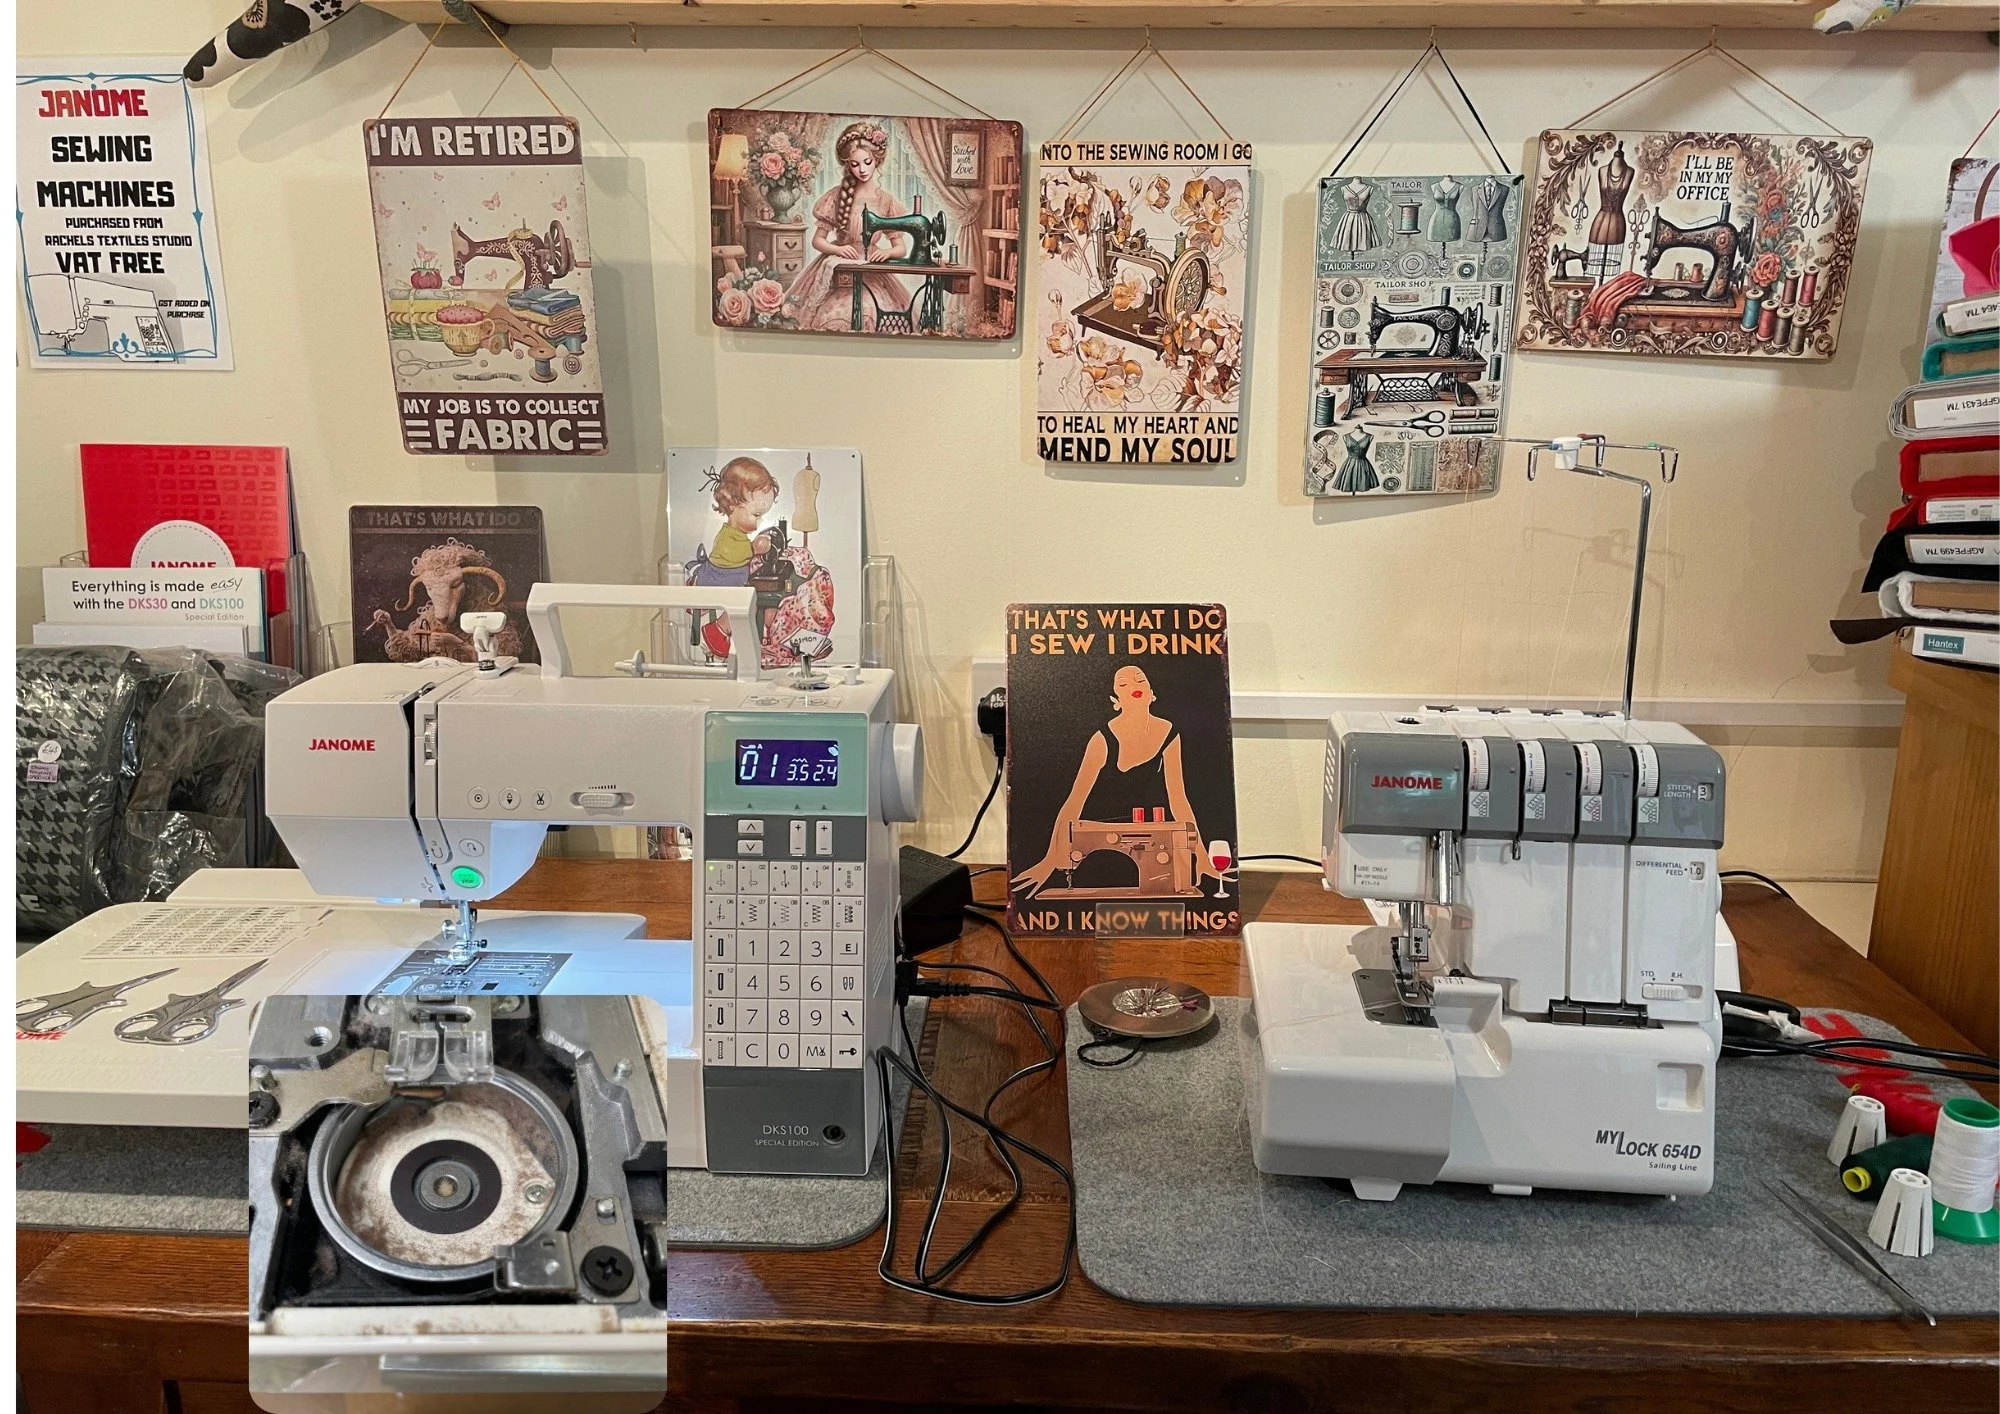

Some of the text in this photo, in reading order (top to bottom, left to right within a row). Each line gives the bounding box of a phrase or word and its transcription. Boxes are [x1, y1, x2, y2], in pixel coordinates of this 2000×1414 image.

[39, 89, 149, 117] JANOME
[370, 124, 575, 157] I'M RETIRED
[51, 135, 152, 162] SEWING
[1040, 144, 1252, 160] NTO THE SEWING ROOM I GO
[954, 163, 973, 175] Love
[1685, 155, 1734, 170] I'LL BE
[1679, 171, 1733, 184] IN MY MY
[36, 180, 175, 208] MACHINES
[1677, 186, 1729, 200] OFFICE
[65, 217, 163, 229] PURCHASED FROM
[45, 235, 192, 247] RACHELS TEXTILES STUDIO
[55, 252, 165, 274] VAT FREE
[1324, 262, 1375, 271] TAILOR SHOP
[158, 299, 173, 307] GST
[404, 399, 599, 415] MY JOB IS TO COLLECT
[1947, 403, 1959, 411] 7M
[1037, 416, 1238, 434] TO HEAL MY HEART AND
[435, 418, 574, 451] FABRIC
[1039, 437, 1237, 462] MEND MY SOUL
[367, 512, 427, 526] THAT'S
[430, 512, 483, 526] WHAT
[495, 512, 521, 526] DO
[72, 577, 243, 595] Everything is made easy
[73, 598, 244, 610] with the DKS30 and DKS100
[185, 613, 244, 622] Special Edition
[1012, 609, 1222, 630] THAT'S WHAT I DO
[1011, 633, 1223, 655] I SEW I DRINK
[1928, 638, 1958, 649] Hantex
[308, 739, 376, 752] JANOME
[740, 750, 837, 781] 01 3.5 2.4
[1371, 775, 1443, 790] JANOME
[1636, 860, 1682, 868] DIFFERENTIAL
[1690, 867, 1701, 875] 1.0
[1017, 911, 1239, 930] AND I KNOW THINGS
[748, 940, 755, 956] 1
[779, 940, 790, 956] 2
[811, 941, 822, 957] 3
[747, 975, 758, 990] 4
[779, 975, 790, 991] 5
[810, 975, 822, 991] 6
[746, 1009, 758, 1025] 7
[778, 1009, 790, 1025] 8
[810, 1010, 822, 1026] 9
[746, 1043, 759, 1058] C
[763, 1125, 809, 1135] DKS100
[755, 1139, 786, 1147] SPECIAL
[1662, 1144, 1701, 1159] 654D
[1649, 1162, 1697, 1171] Sailing Line
